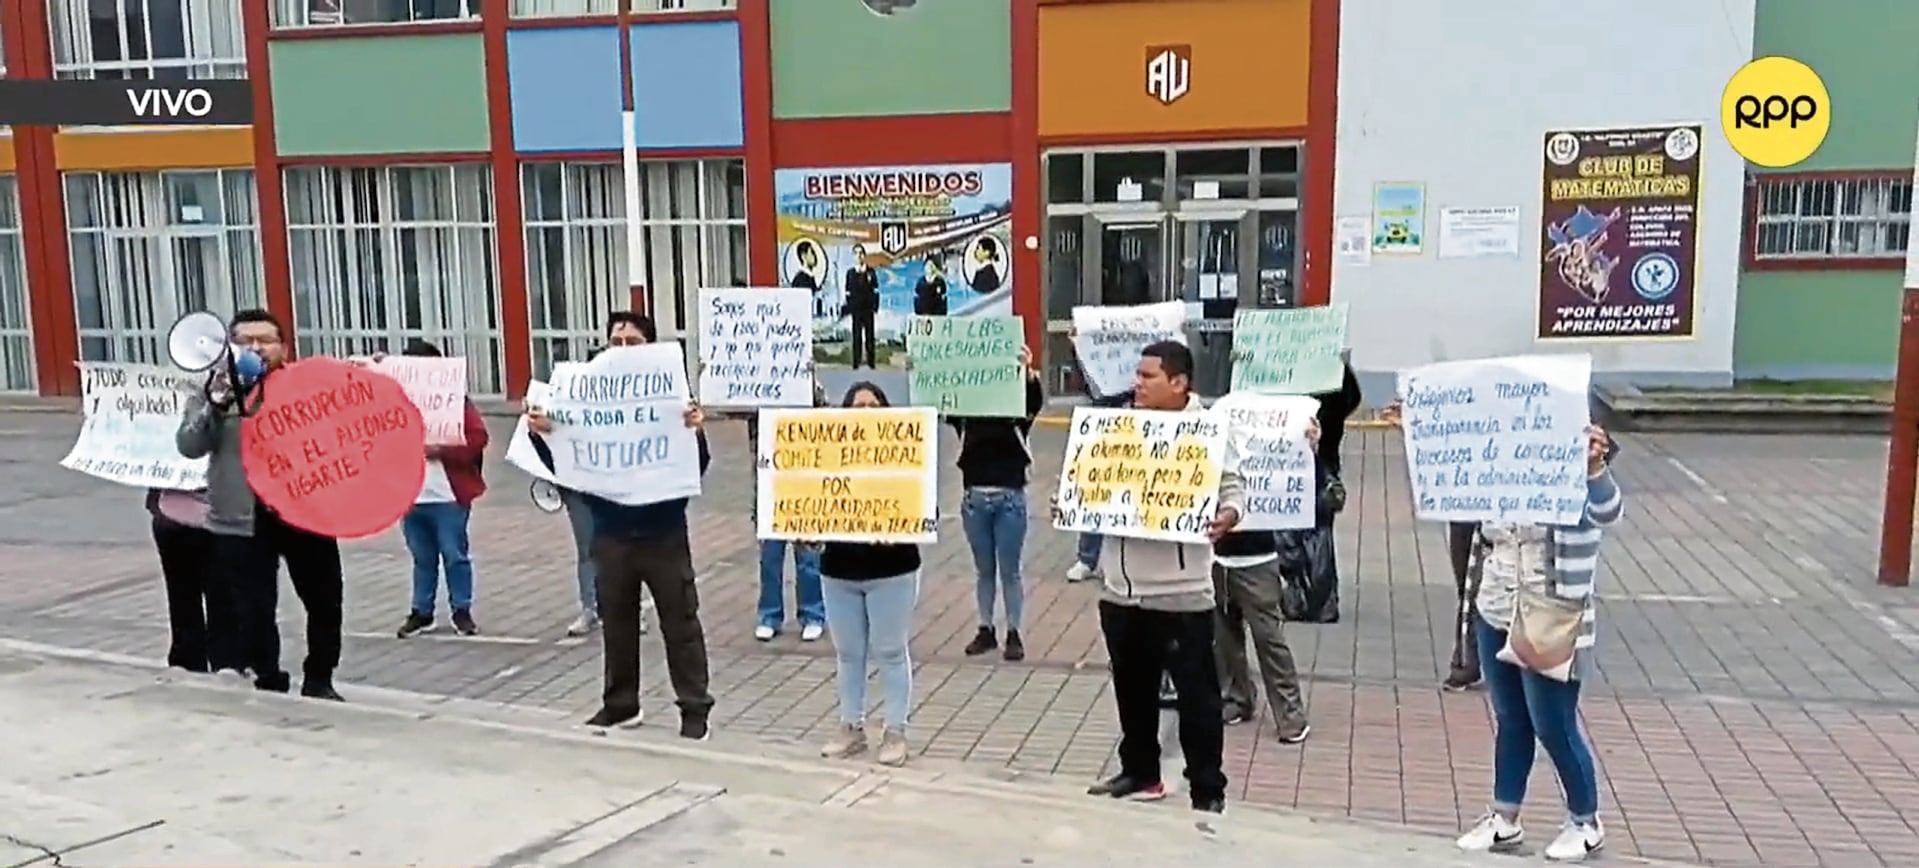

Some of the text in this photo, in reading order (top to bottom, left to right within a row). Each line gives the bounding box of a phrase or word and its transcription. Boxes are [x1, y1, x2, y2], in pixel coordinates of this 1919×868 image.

[1580, 156, 1663, 177] CLUB DE
[804, 171, 982, 200] BIENVENIDOS
[1556, 304, 1675, 319] "POR MEJORES
[941, 319, 953, 338] A
[967, 318, 1004, 338] LAS
[568, 367, 674, 401] CORRUPCIÓN
[1494, 381, 1550, 412] mayor
[582, 408, 625, 428] ROBA
[634, 405, 660, 424] EL
[1079, 415, 1092, 436] 6
[265, 453, 294, 479] EN
[303, 437, 327, 464] EL
[335, 405, 410, 449] ALFONSO
[775, 419, 924, 443] RENUNCIA de VOCAL
[568, 434, 670, 470] FUTURO
[1073, 442, 1084, 462] y
[1149, 440, 1170, 461] NO
[1175, 445, 1209, 462] usan
[285, 458, 361, 500] UGARTE
[822, 476, 851, 497] POR
[1151, 468, 1183, 494] pero
[1286, 474, 1305, 493] DE
[1454, 464, 1470, 487] la
[1121, 488, 1132, 505] a
[1197, 496, 1211, 515] y
[1160, 515, 1171, 531] a
